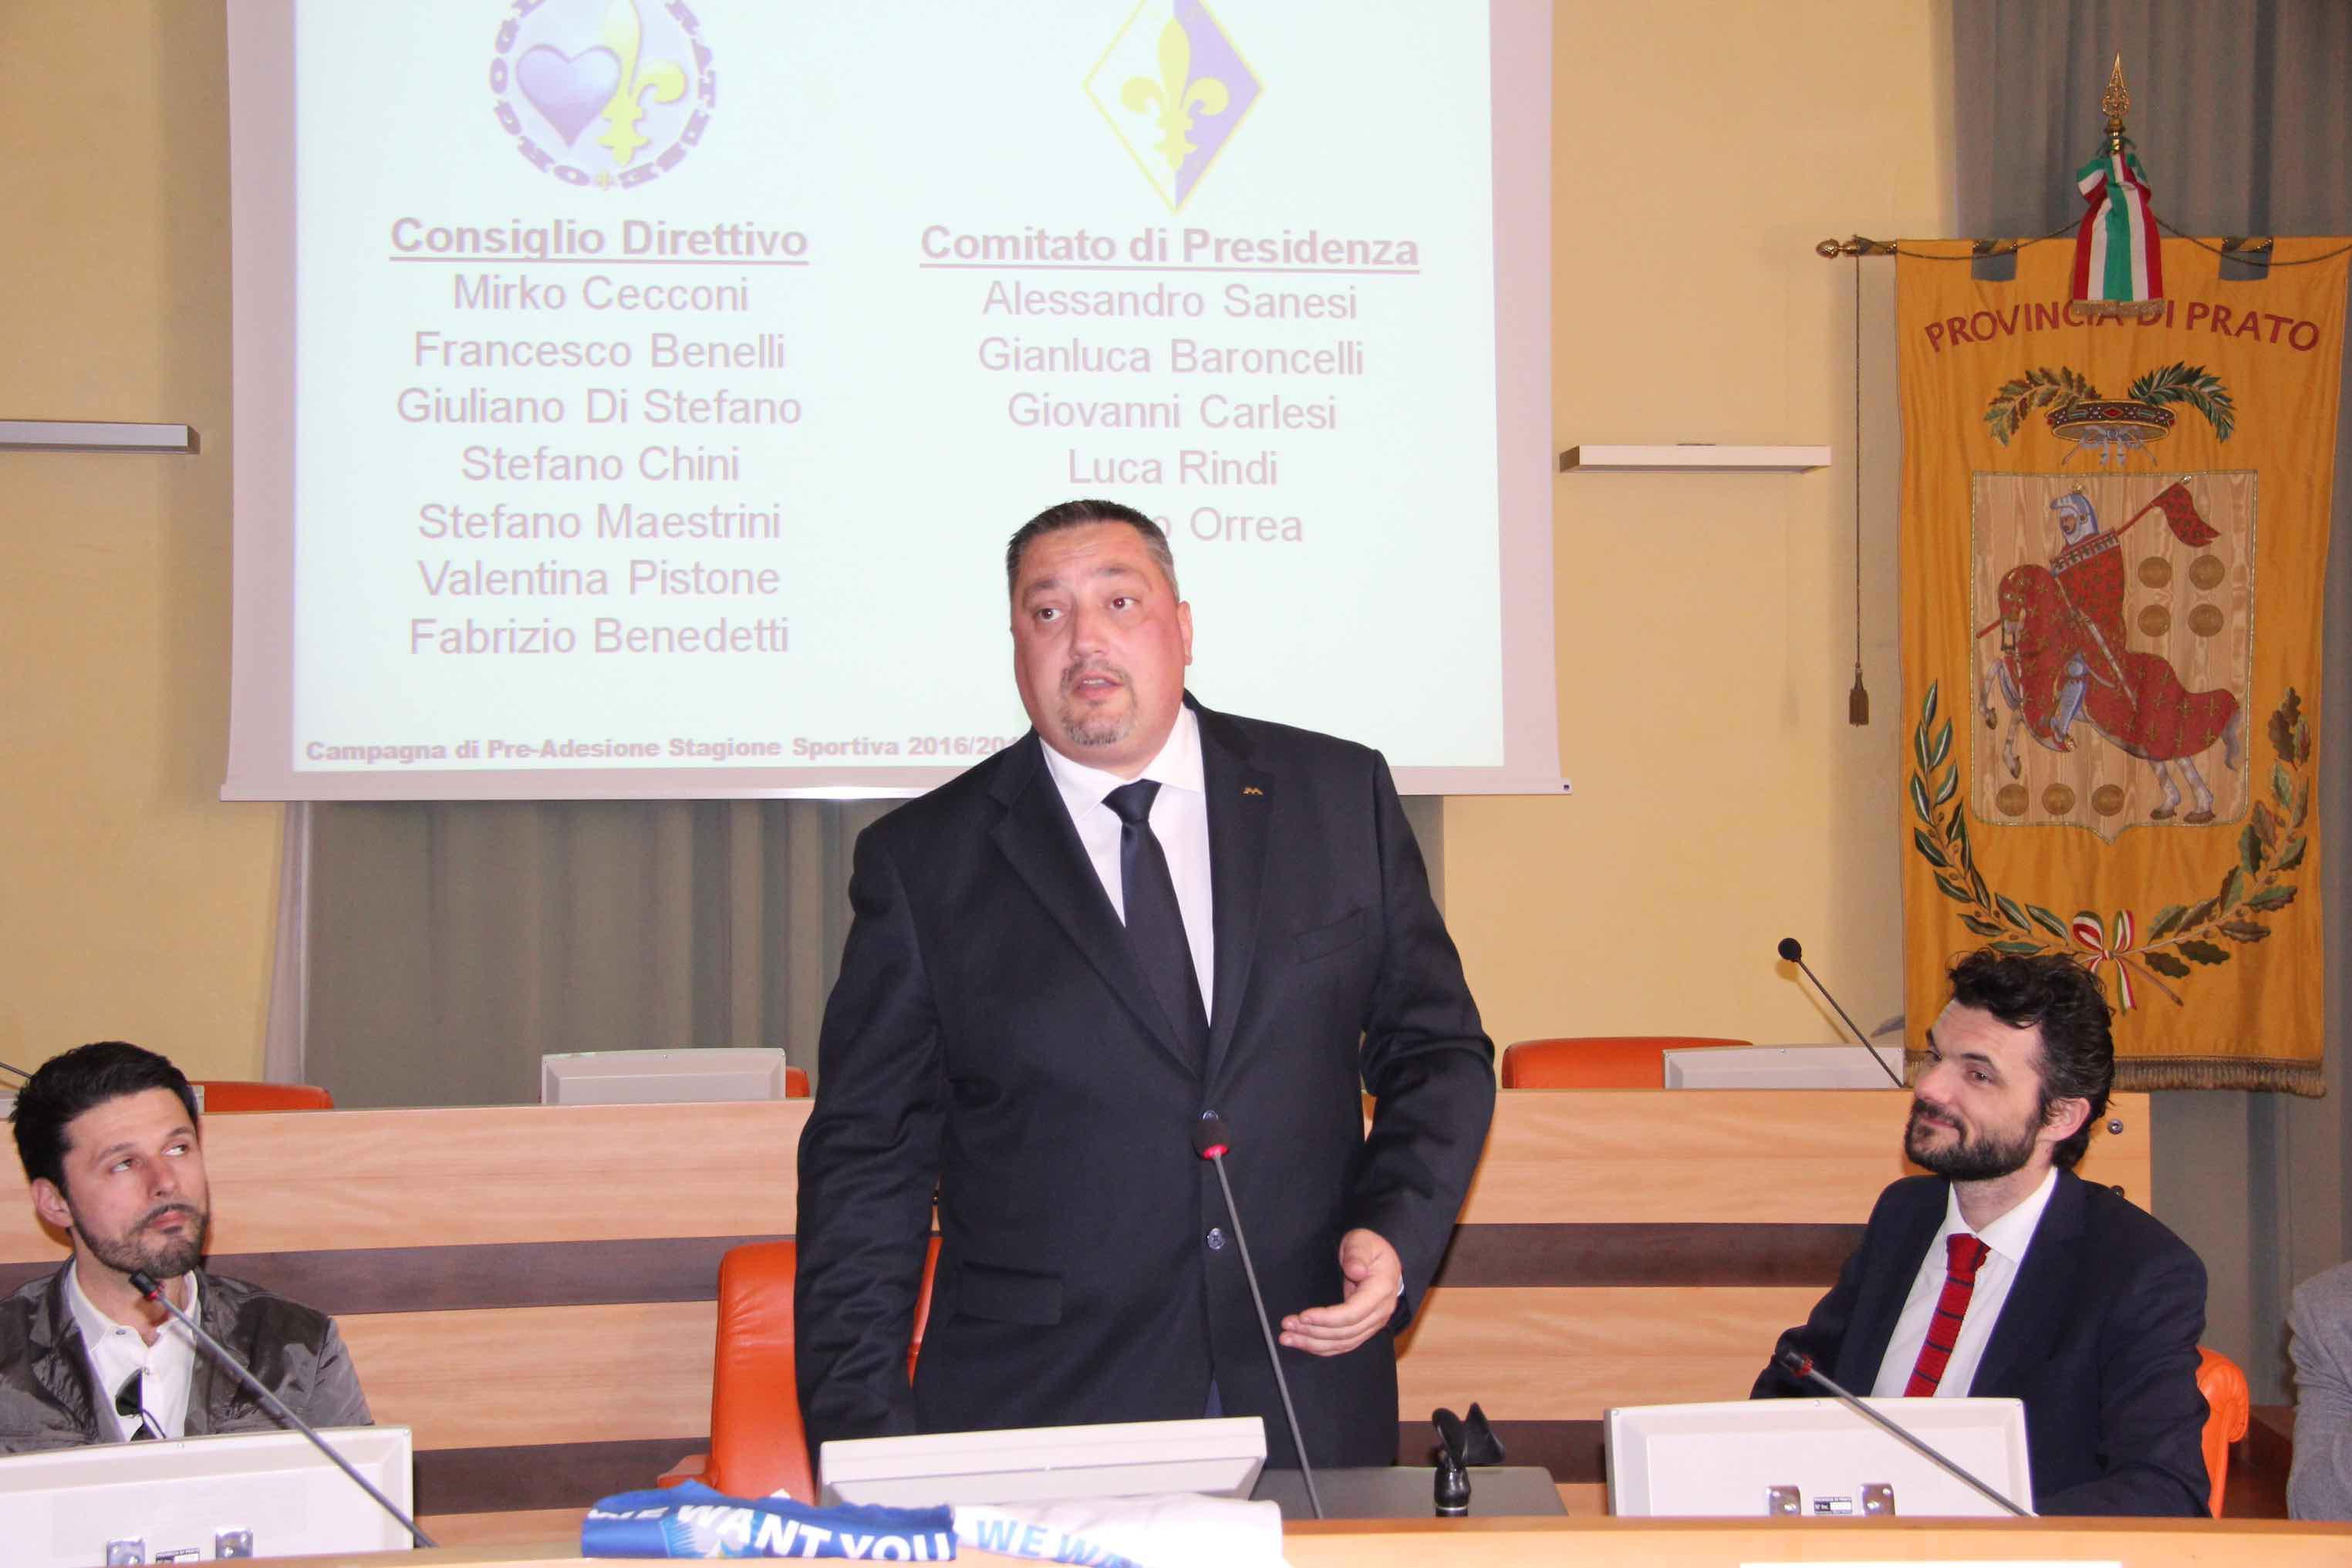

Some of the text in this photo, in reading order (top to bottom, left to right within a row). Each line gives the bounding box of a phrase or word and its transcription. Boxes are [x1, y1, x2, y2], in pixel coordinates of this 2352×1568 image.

[391, 217, 809, 258] Consiglio Direttivo
[923, 226, 1419, 266] Comitato di Presidenza
[456, 275, 748, 312] Mirko Cecconi
[984, 282, 1357, 320] Alessandro Sanesi
[2186, 302, 2320, 351] PRATO
[417, 332, 785, 369] Francesco Benelli
[980, 337, 1364, 376] Gianluca Baroncelli
[398, 388, 802, 425] Giuliano Di Stefano
[1009, 393, 1336, 430] Giovanni Carlesi
[463, 446, 739, 482] Stefano Chini
[1070, 450, 1278, 487] Luca Rindi
[420, 504, 781, 540] Stefano Maestrini
[1191, 507, 1303, 543] Orrea
[419, 560, 781, 597] Valentina Pistone
[412, 618, 789, 655] Fabrizio Benedetti
[306, 736, 1019, 764] Campagna di Pre-Adesione Stagione Sportiva 2016/20
[977, 1519, 1048, 1557] WE
